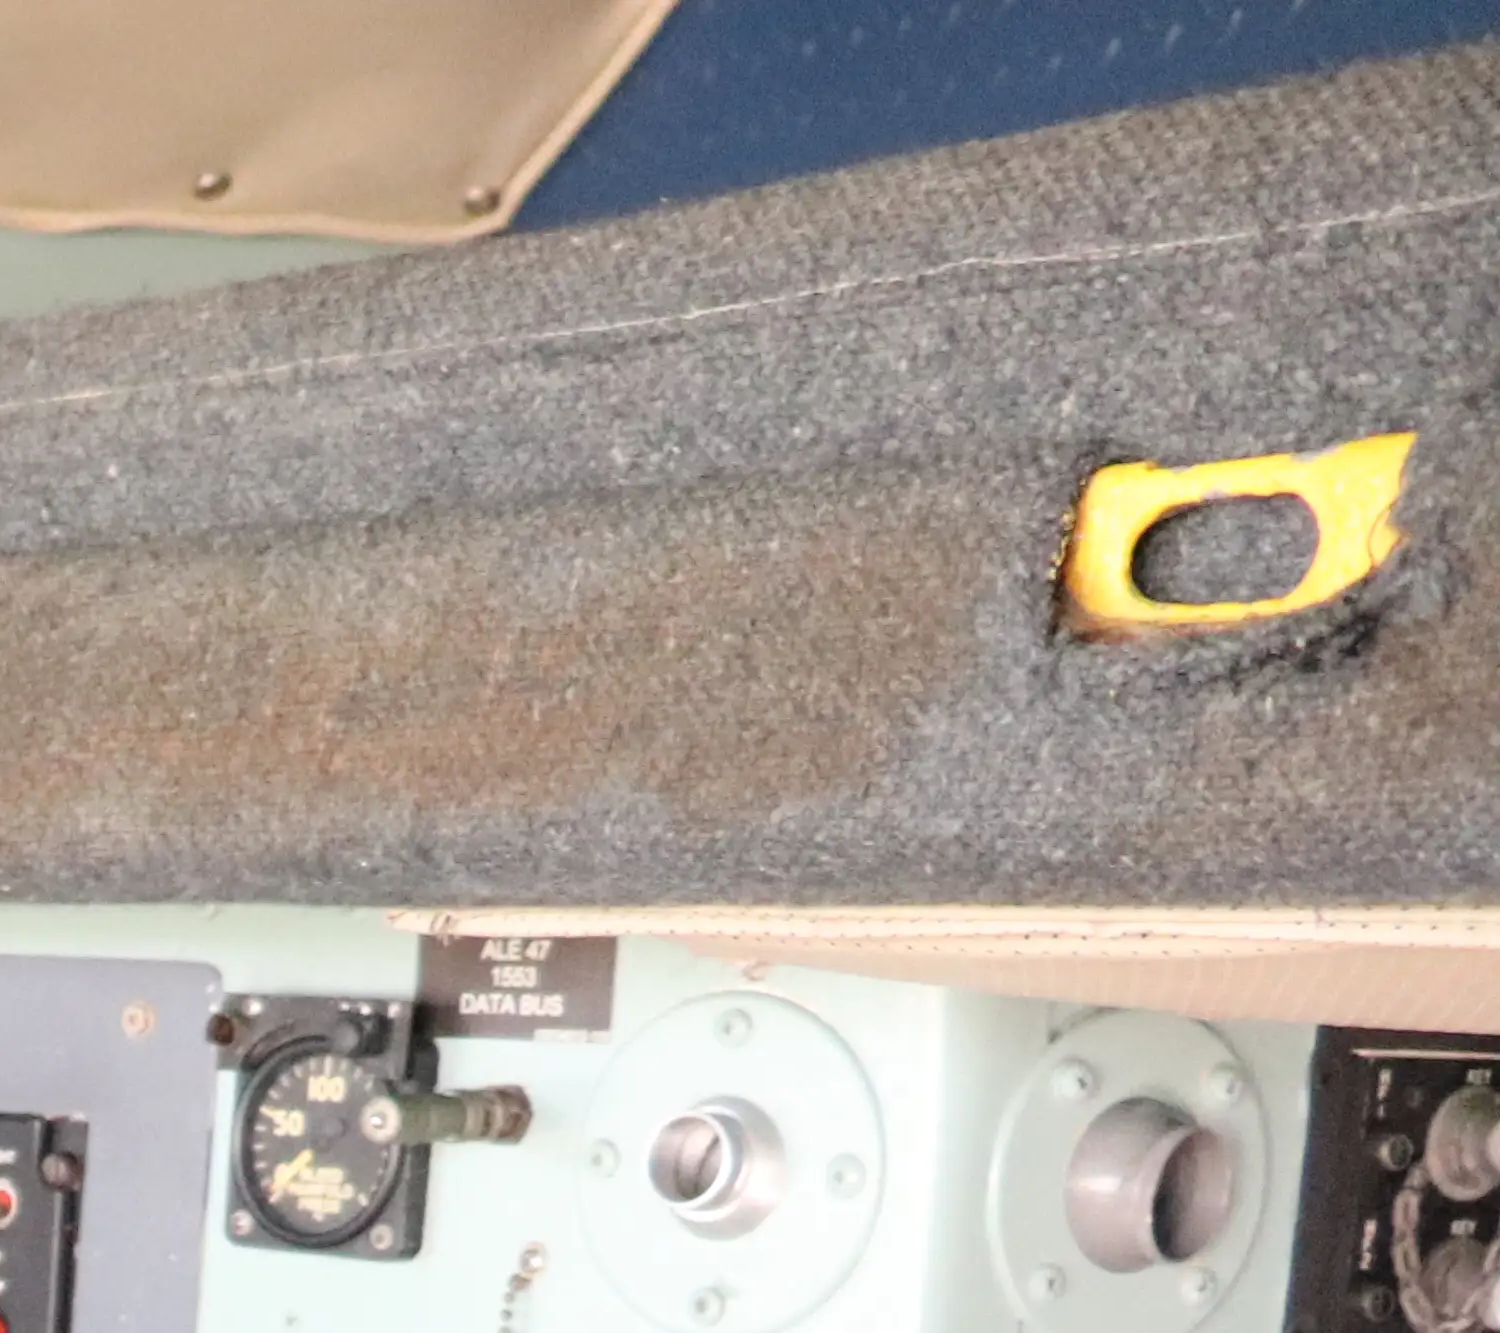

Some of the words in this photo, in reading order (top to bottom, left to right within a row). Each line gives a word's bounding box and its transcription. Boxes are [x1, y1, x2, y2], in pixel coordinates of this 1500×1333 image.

[479, 938, 523, 961] ALE
[525, 938, 553, 961] 47
[458, 991, 517, 1015] DATA
[519, 994, 565, 1017] BUS
[308, 1079, 345, 1103] 100
